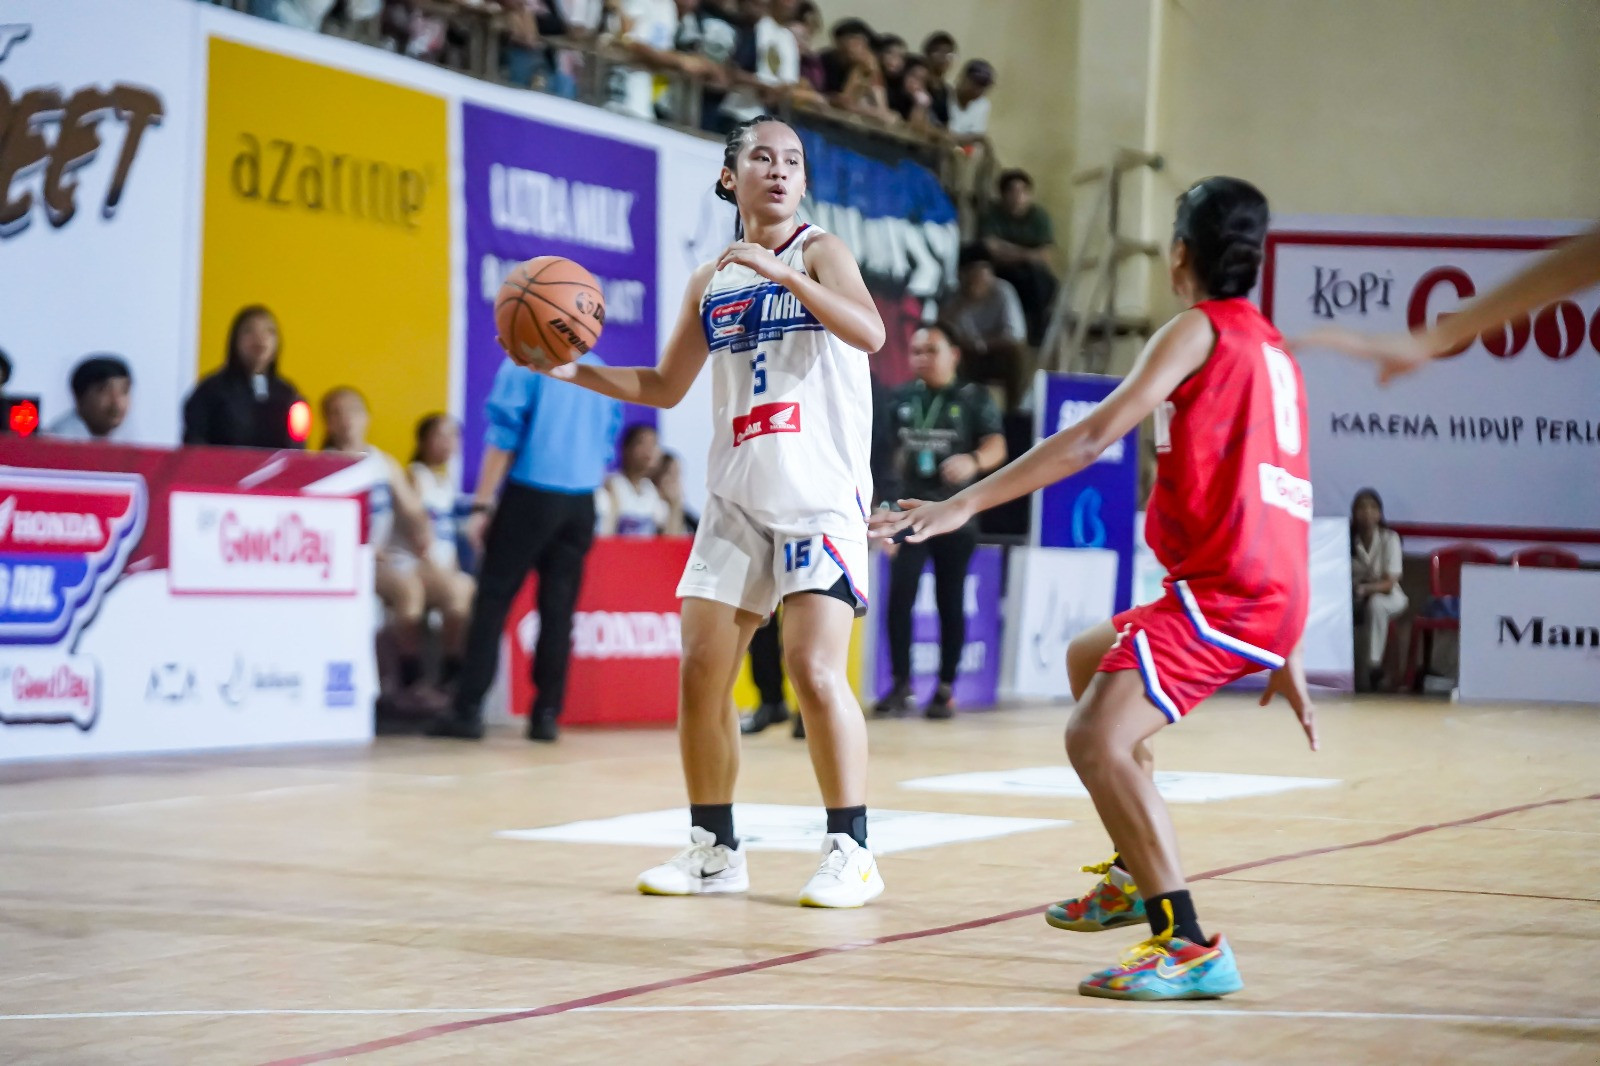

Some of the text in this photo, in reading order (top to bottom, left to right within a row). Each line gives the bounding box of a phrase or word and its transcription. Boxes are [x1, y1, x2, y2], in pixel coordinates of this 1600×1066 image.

[1332, 411, 1439, 439] KARENA
[1450, 415, 1524, 444] HIDUP
[12, 511, 104, 546] HONDA
[785, 538, 812, 573] 15
